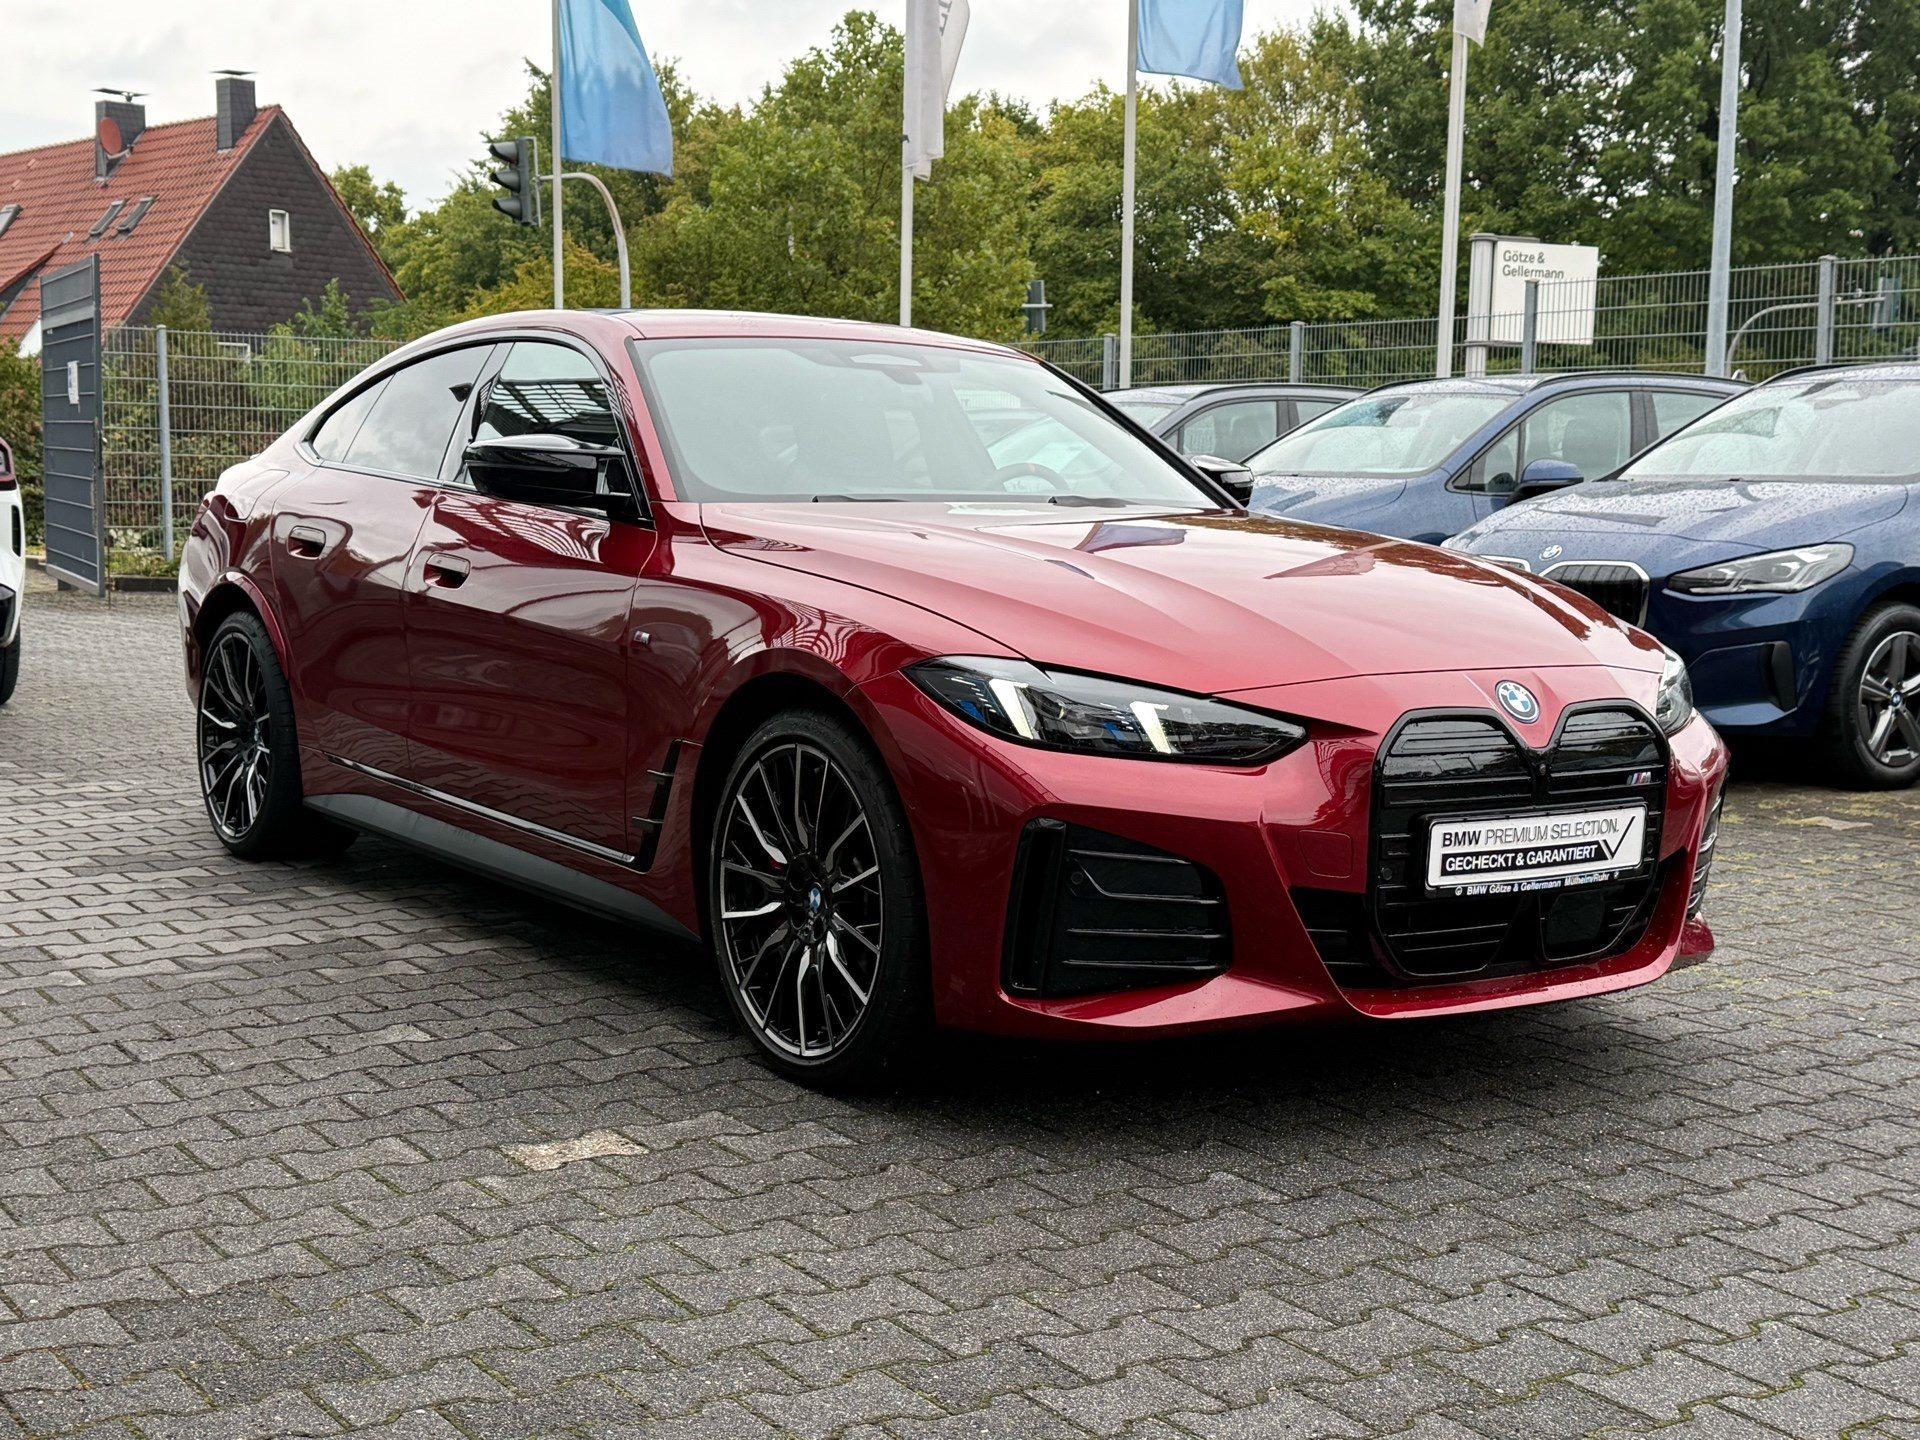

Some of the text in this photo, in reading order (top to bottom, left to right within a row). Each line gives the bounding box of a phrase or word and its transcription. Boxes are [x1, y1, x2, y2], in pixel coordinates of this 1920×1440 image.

[1502, 250, 1545, 263] Götze &
[1502, 264, 1564, 279] Gellermann
[1442, 830, 1481, 848] BMW
[1485, 825, 1548, 845] PREMIUM
[1445, 844, 1598, 872] GECHECKT & GARANTIERT
[1466, 886, 1487, 895] BMW
[1489, 884, 1512, 894] Götze
[1513, 883, 1519, 892] &
